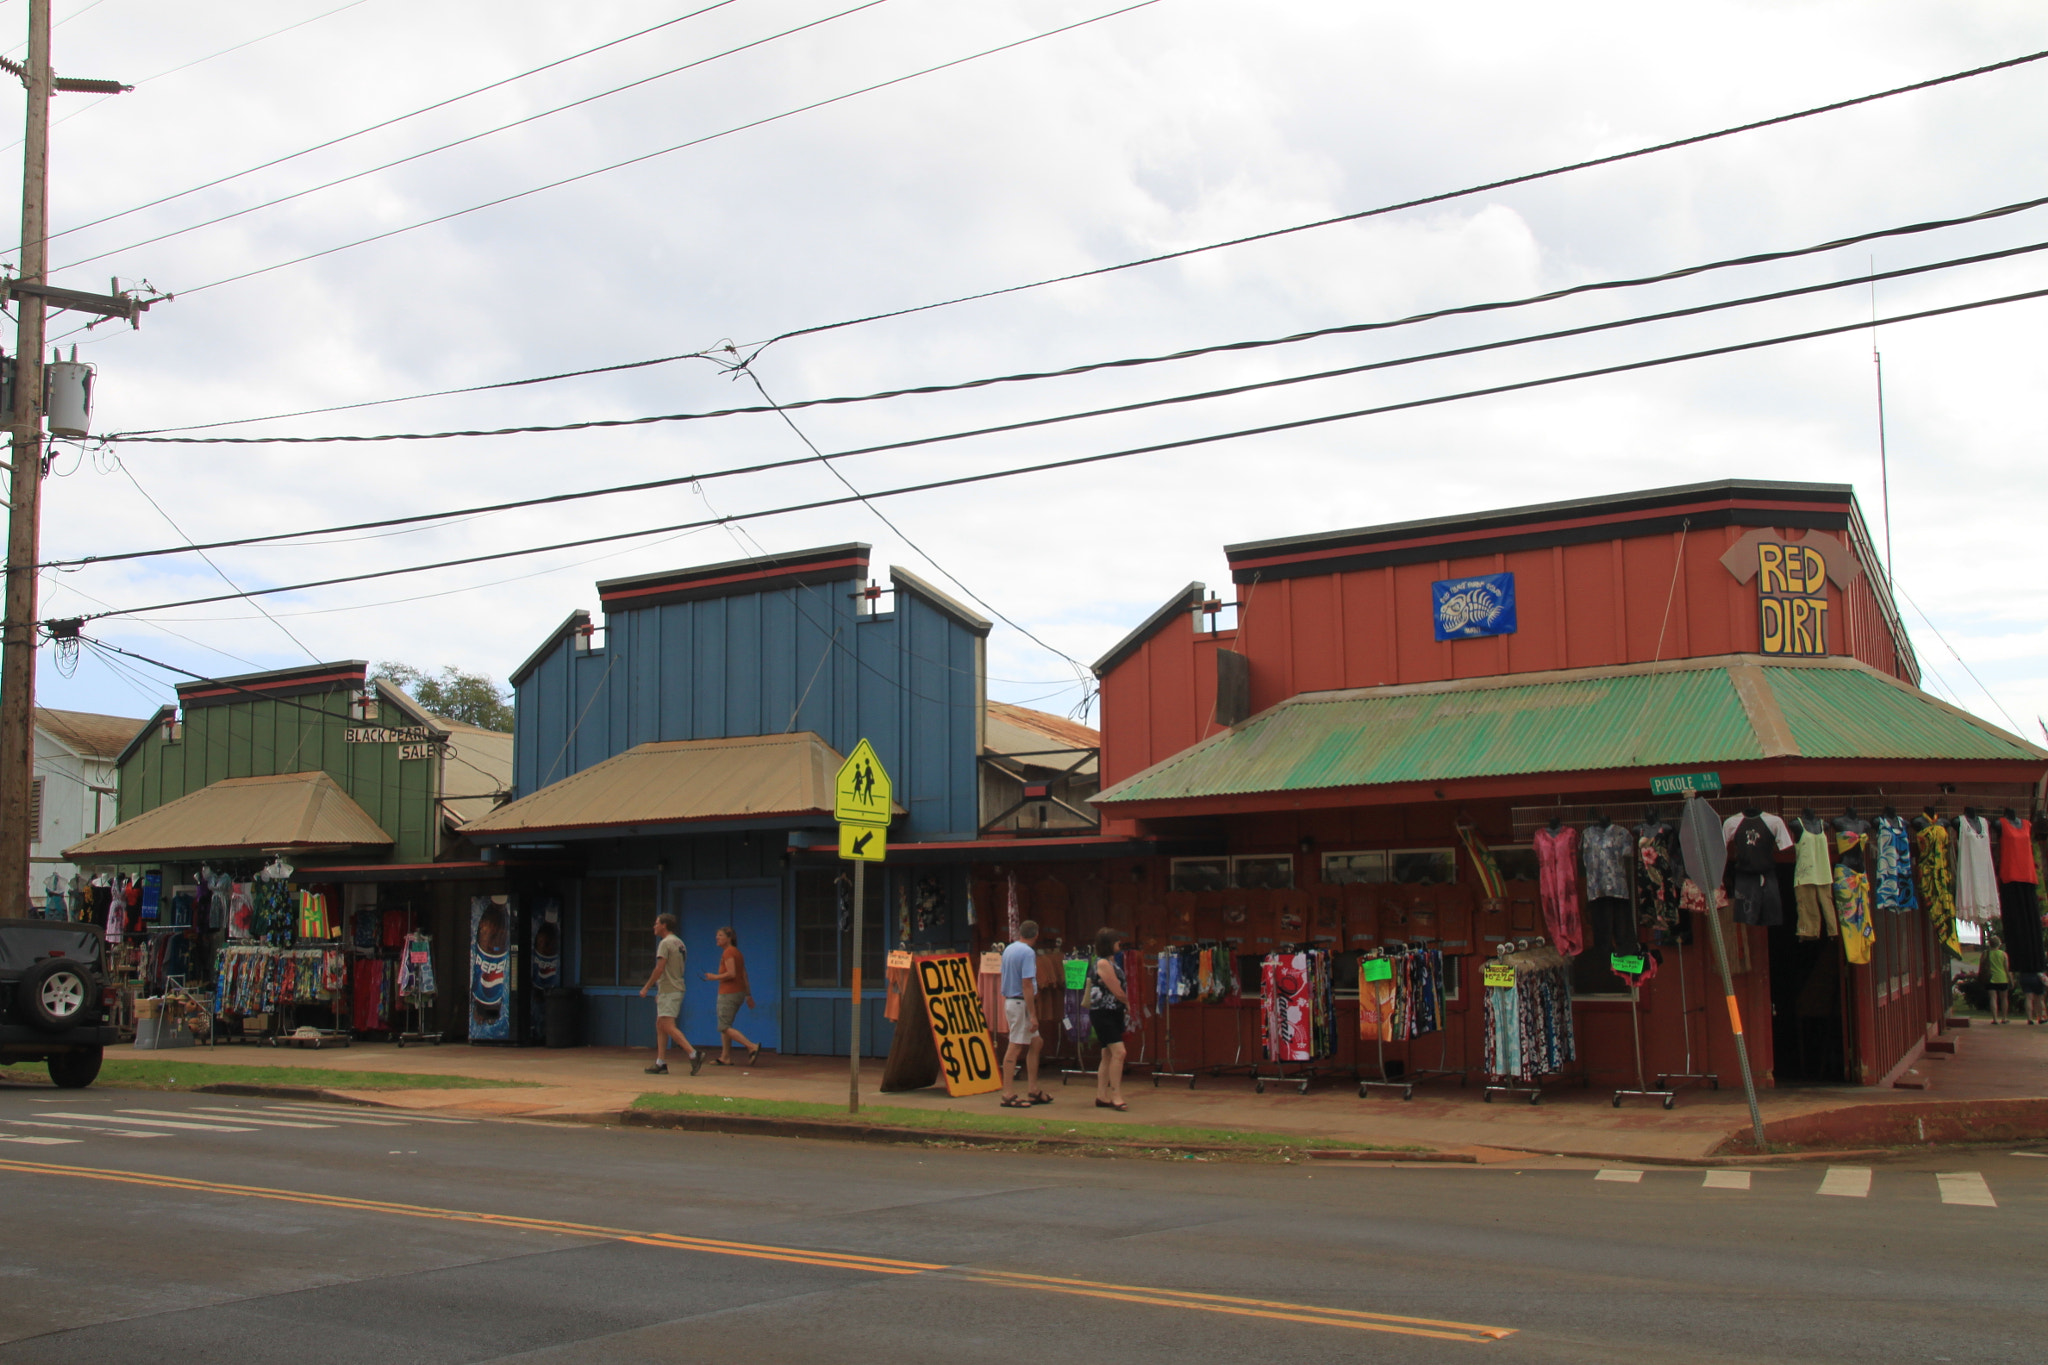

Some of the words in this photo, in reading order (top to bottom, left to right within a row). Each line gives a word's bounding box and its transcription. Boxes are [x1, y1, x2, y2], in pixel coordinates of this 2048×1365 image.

[1758, 543, 1826, 594] RED
[1760, 597, 1828, 655] DIRT
[346, 729, 385, 742] BLACK
[389, 727, 429, 742] PEARL
[402, 744, 434, 759] SALE
[1655, 776, 1694, 792] POKOLE
[475, 954, 507, 973] PEPSI
[920, 957, 973, 995] DIRT
[1277, 972, 1298, 1045] Hawaii
[940, 1036, 991, 1083] $10
